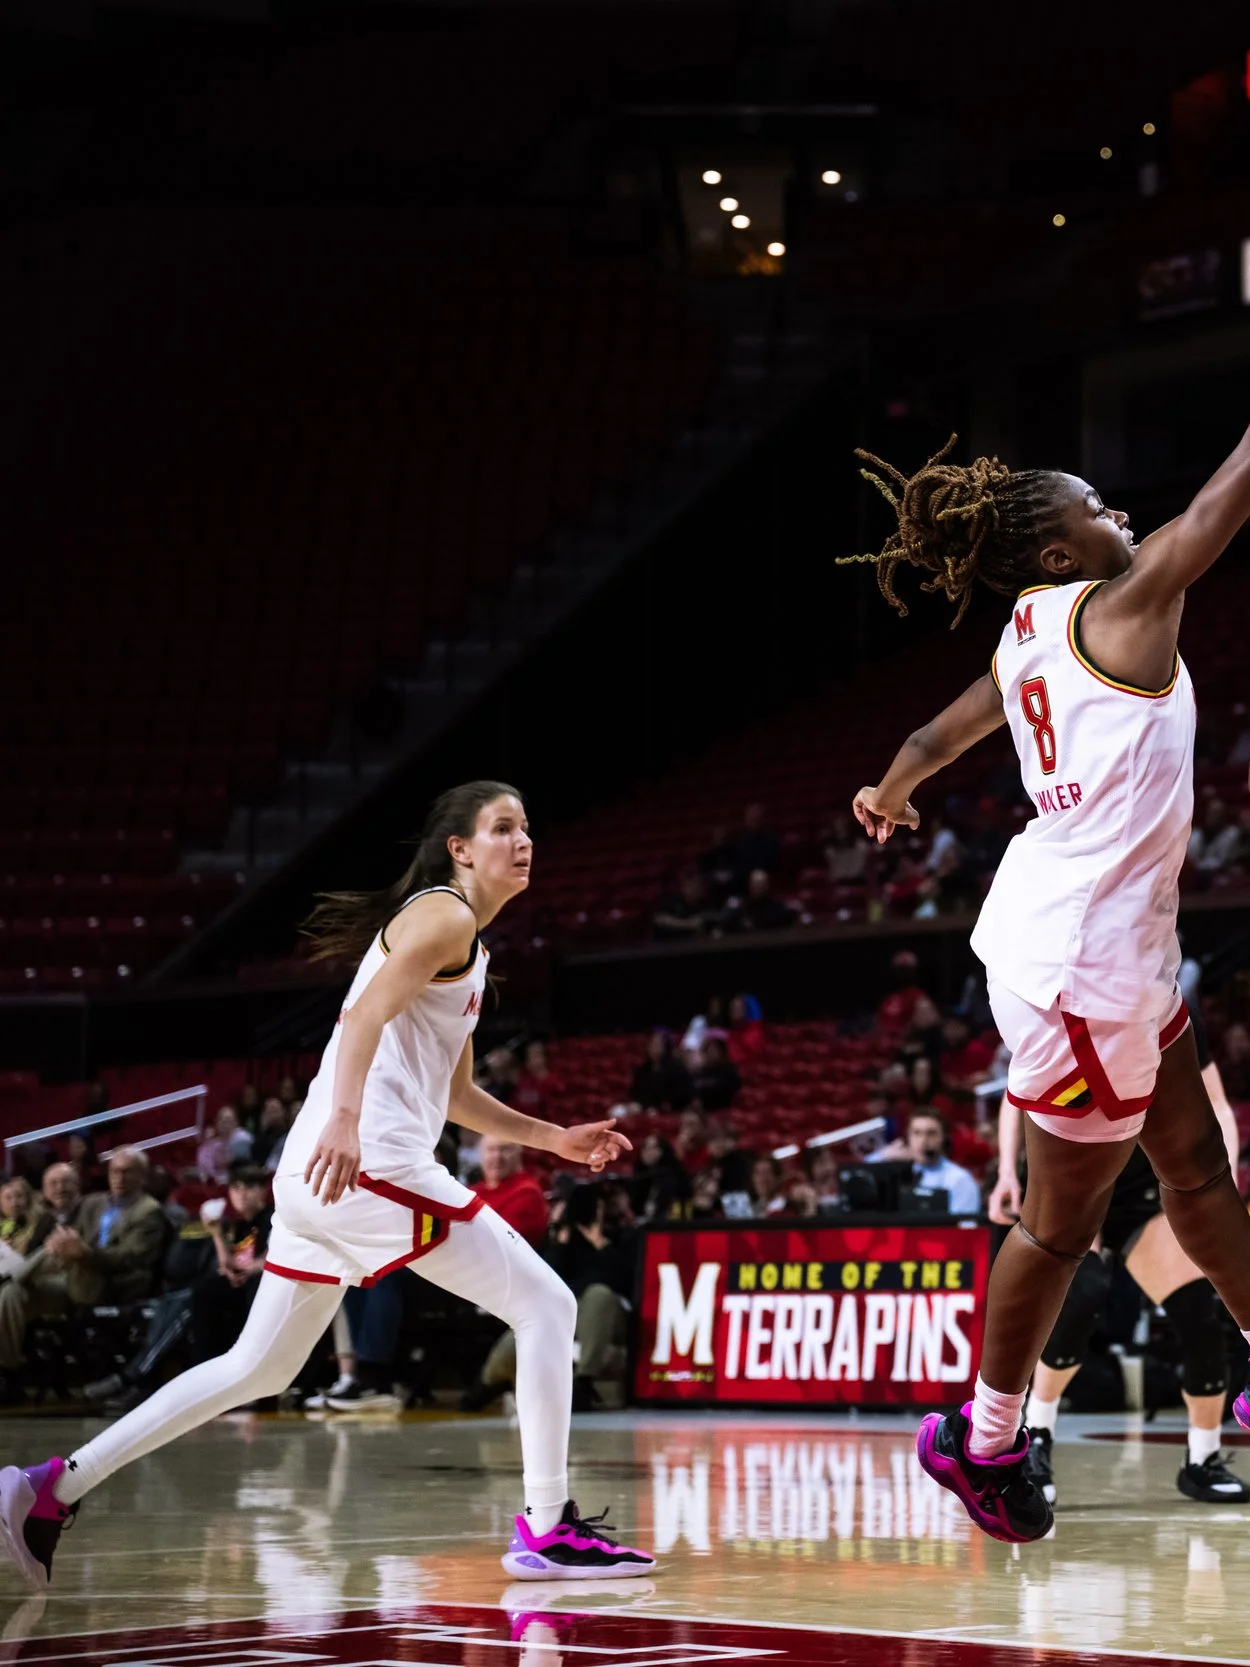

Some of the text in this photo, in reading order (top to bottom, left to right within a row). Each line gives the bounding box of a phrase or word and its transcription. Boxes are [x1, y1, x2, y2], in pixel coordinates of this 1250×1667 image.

[1014, 602, 1036, 641] M
[1020, 676, 1056, 775] 8
[651, 1262, 721, 1366] M
[738, 1262, 963, 1290] HOME OF THE
[722, 1293, 975, 1383] TERRAPINS
